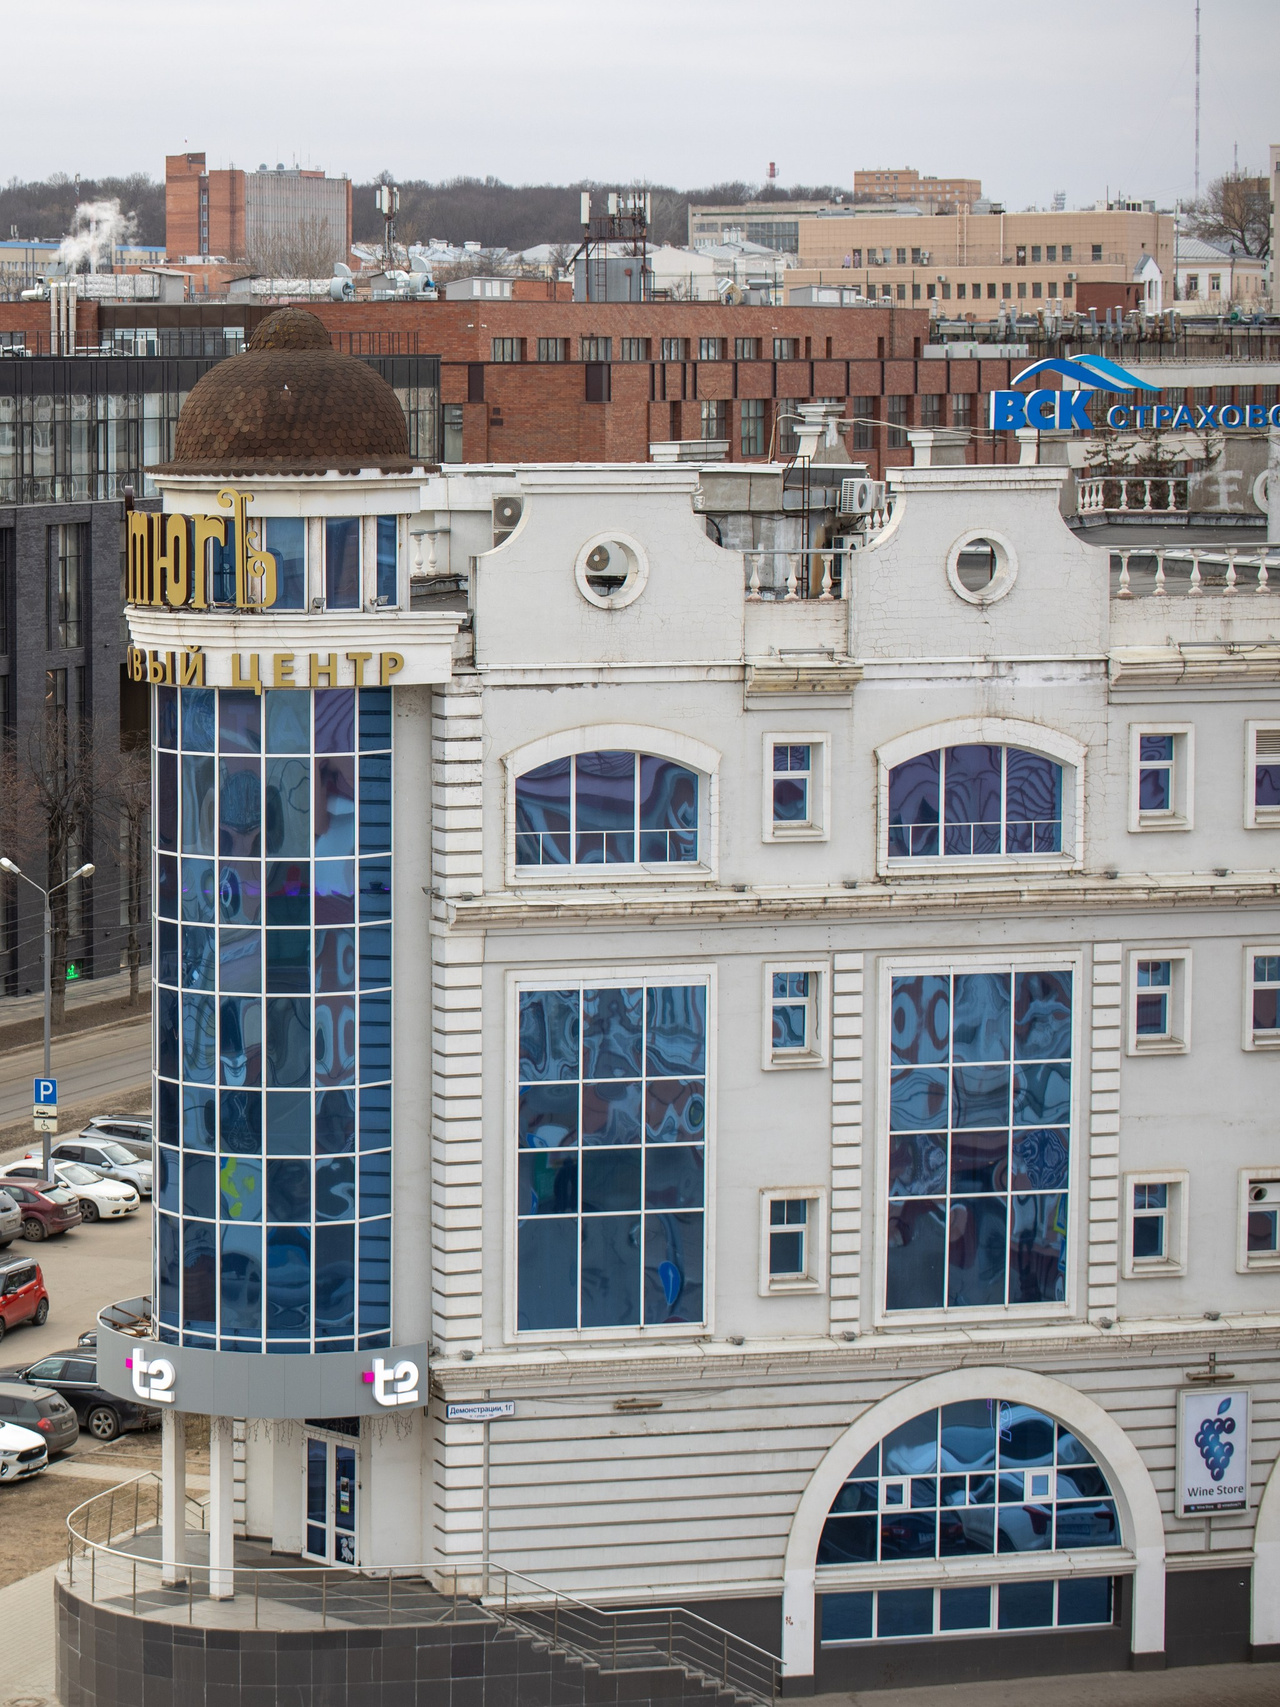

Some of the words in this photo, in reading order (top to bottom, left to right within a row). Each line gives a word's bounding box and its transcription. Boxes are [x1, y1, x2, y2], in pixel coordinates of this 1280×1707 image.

[990, 388, 1095, 430] ВСК
[231, 651, 405, 696] ЦЕНТР
[40, 1081, 53, 1102] P
[125, 1347, 176, 1403] t2
[362, 1357, 419, 1406] t2
[1187, 1486, 1215, 1498] Wine
[1216, 1485, 1244, 1496] Store
